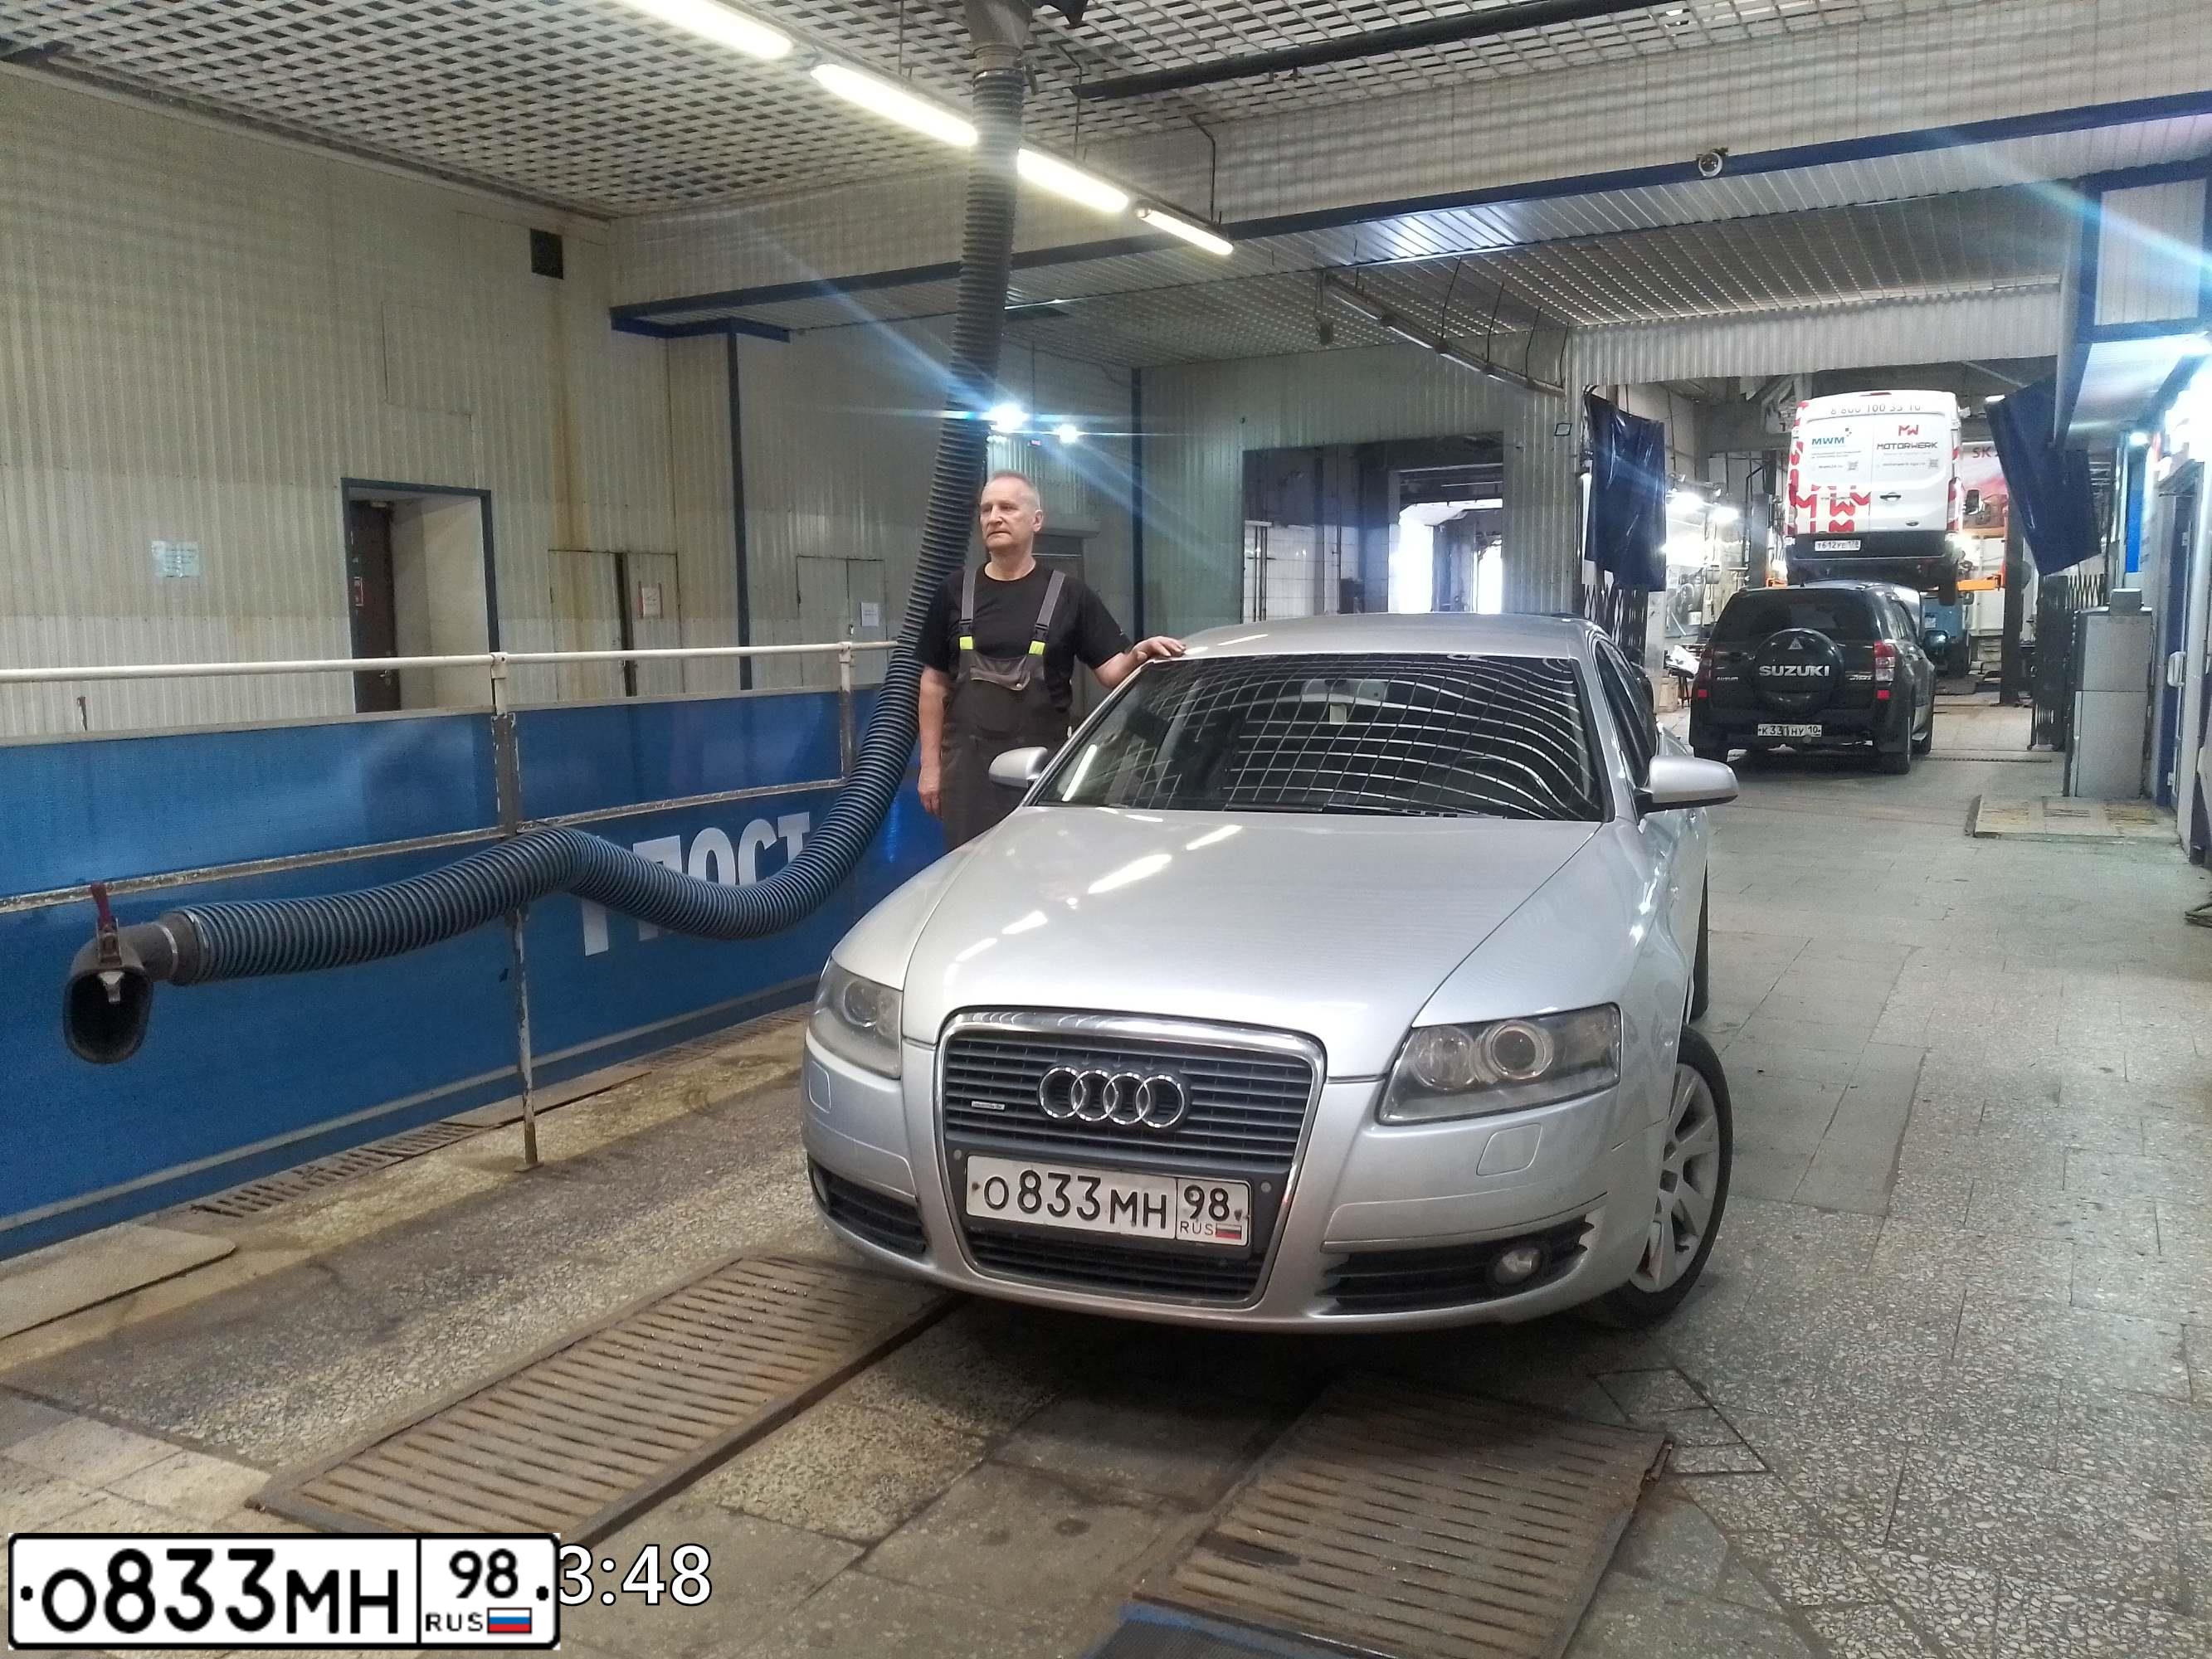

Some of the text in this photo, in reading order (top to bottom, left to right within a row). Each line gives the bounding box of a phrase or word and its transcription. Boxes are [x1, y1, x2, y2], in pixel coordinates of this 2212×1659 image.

[1867, 403, 1886, 412] 100
[1811, 436, 1844, 445] MWM
[1876, 441, 1938, 450] MOTORWERK
[1758, 665, 1830, 677] SUZUKI
[1808, 725, 1819, 733] 10
[983, 1170, 1230, 1229] О833МН 98
[1179, 1221, 1214, 1236] RUS
